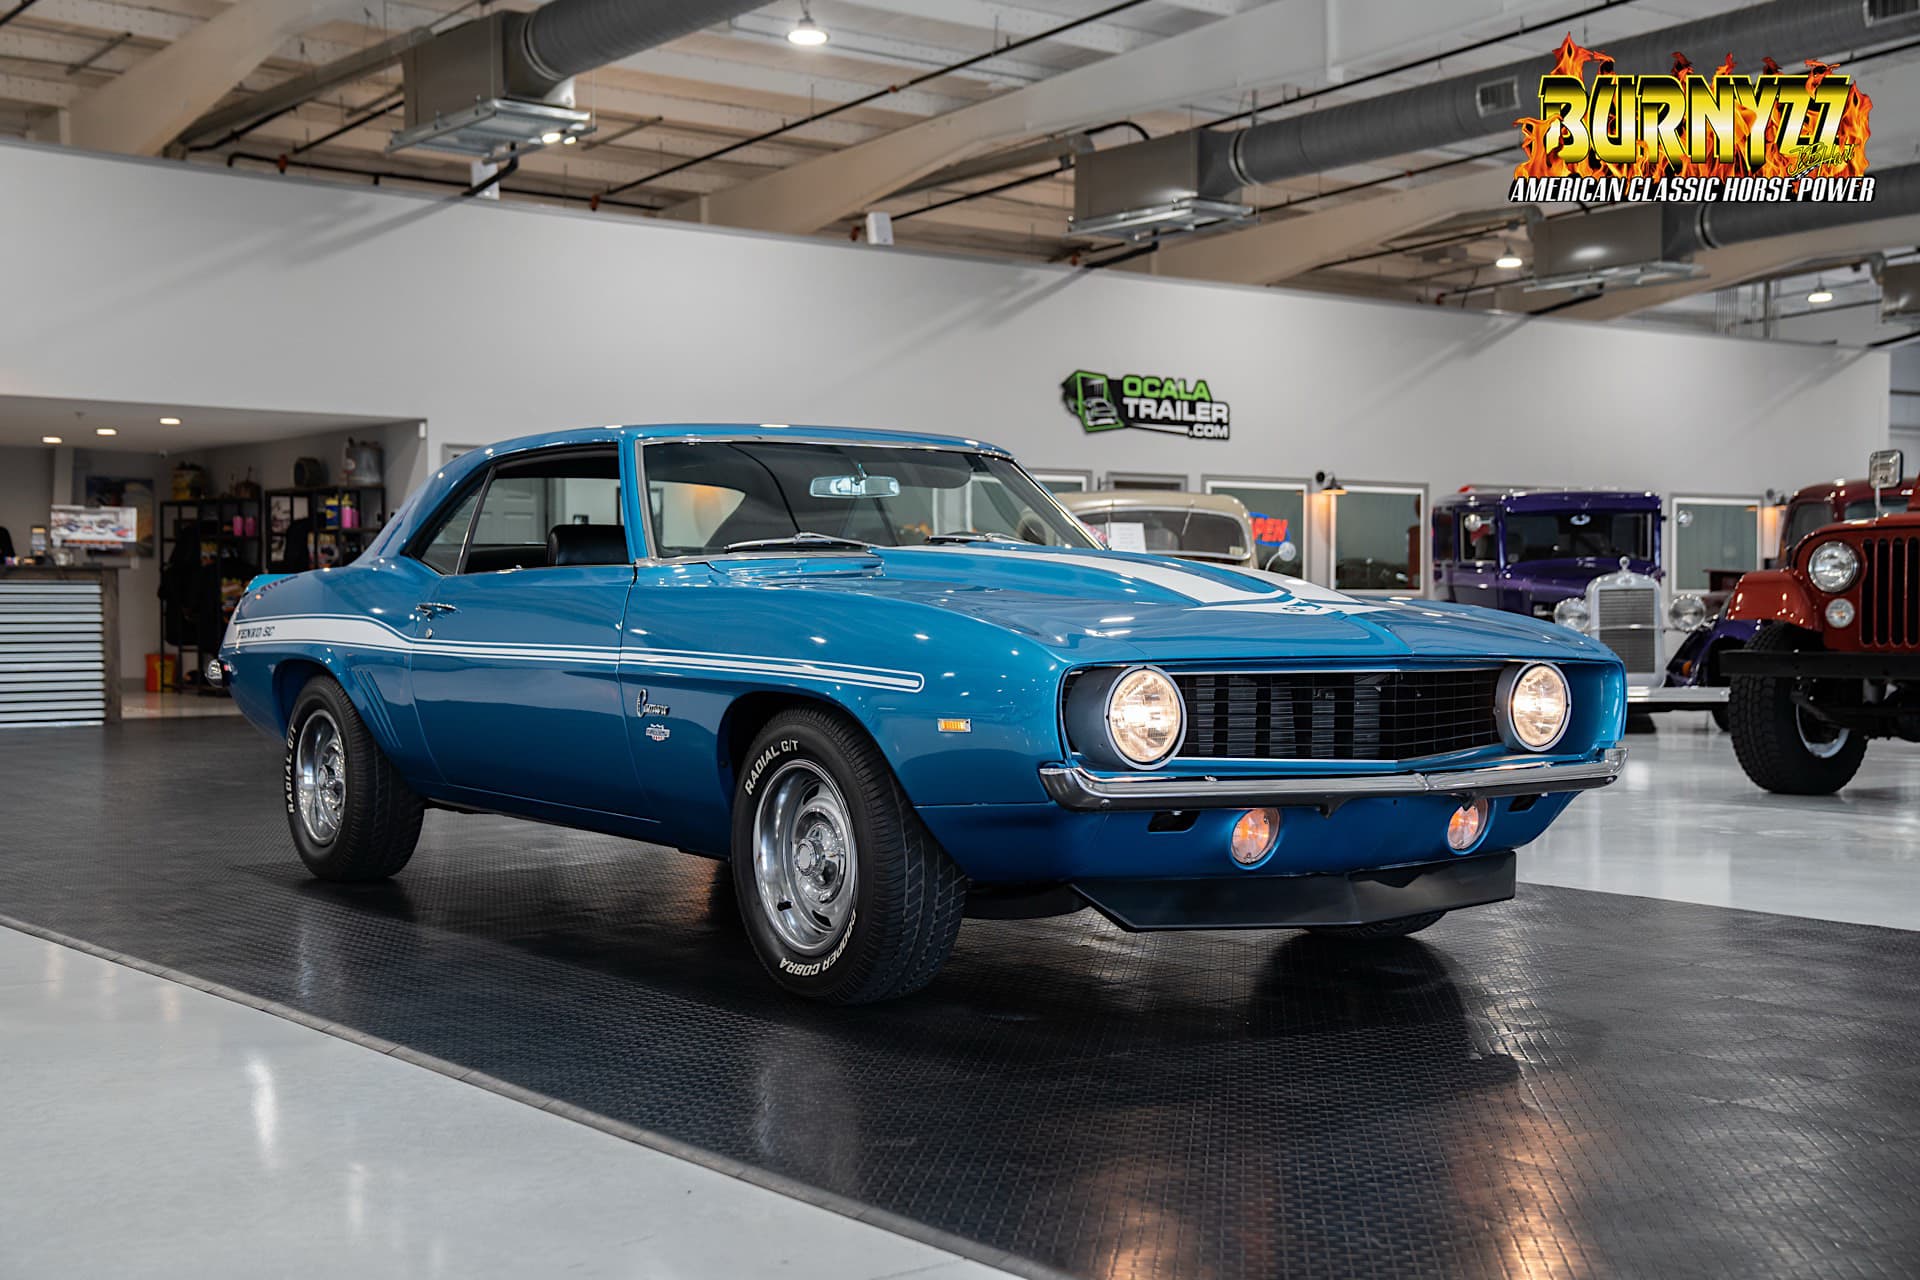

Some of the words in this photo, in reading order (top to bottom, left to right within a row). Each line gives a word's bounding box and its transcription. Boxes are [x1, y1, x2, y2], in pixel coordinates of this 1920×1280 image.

[1122, 375, 1212, 401] OCALA
[1122, 397, 1229, 424] TRAILER
[1188, 423, 1229, 439] .COM
[744, 745, 780, 796] RADIAL
[780, 739, 799, 752] G/T
[779, 957, 821, 976] COBRA
